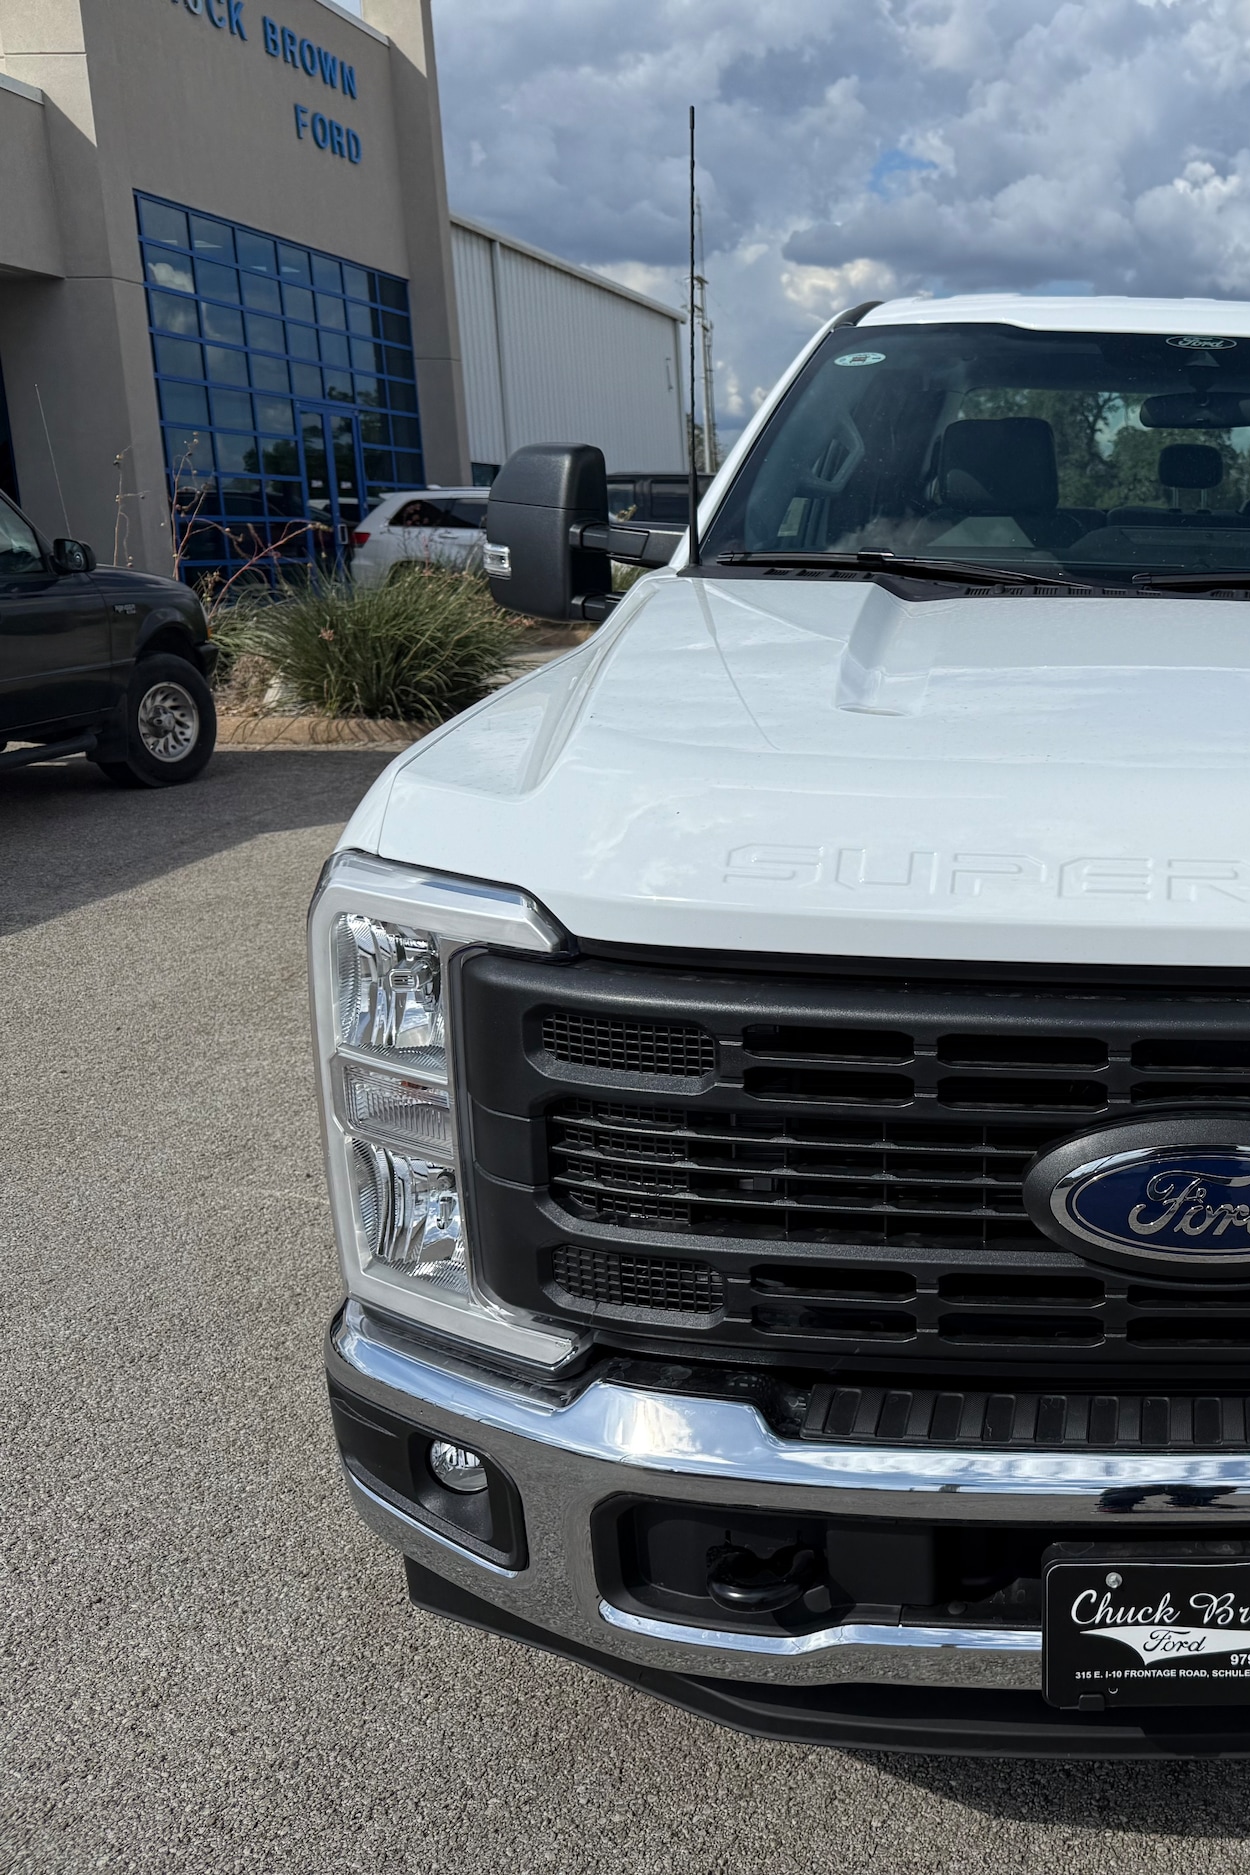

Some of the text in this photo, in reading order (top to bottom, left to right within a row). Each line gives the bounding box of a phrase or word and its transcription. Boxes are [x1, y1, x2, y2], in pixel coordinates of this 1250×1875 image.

[171, 0, 358, 100] CK BROWN
[293, 103, 363, 164] FORD
[1178, 337, 1224, 348] Ford
[1070, 1589, 1181, 1626] Chuck
[1142, 1628, 1207, 1653] Ford
[1075, 1671, 1092, 1680] 315
[1093, 1671, 1104, 1679] E.
[1105, 1670, 1123, 1679] I-10
[1124, 1669, 1177, 1679] FRONTAGE
[1179, 1669, 1210, 1679] ROAD,
